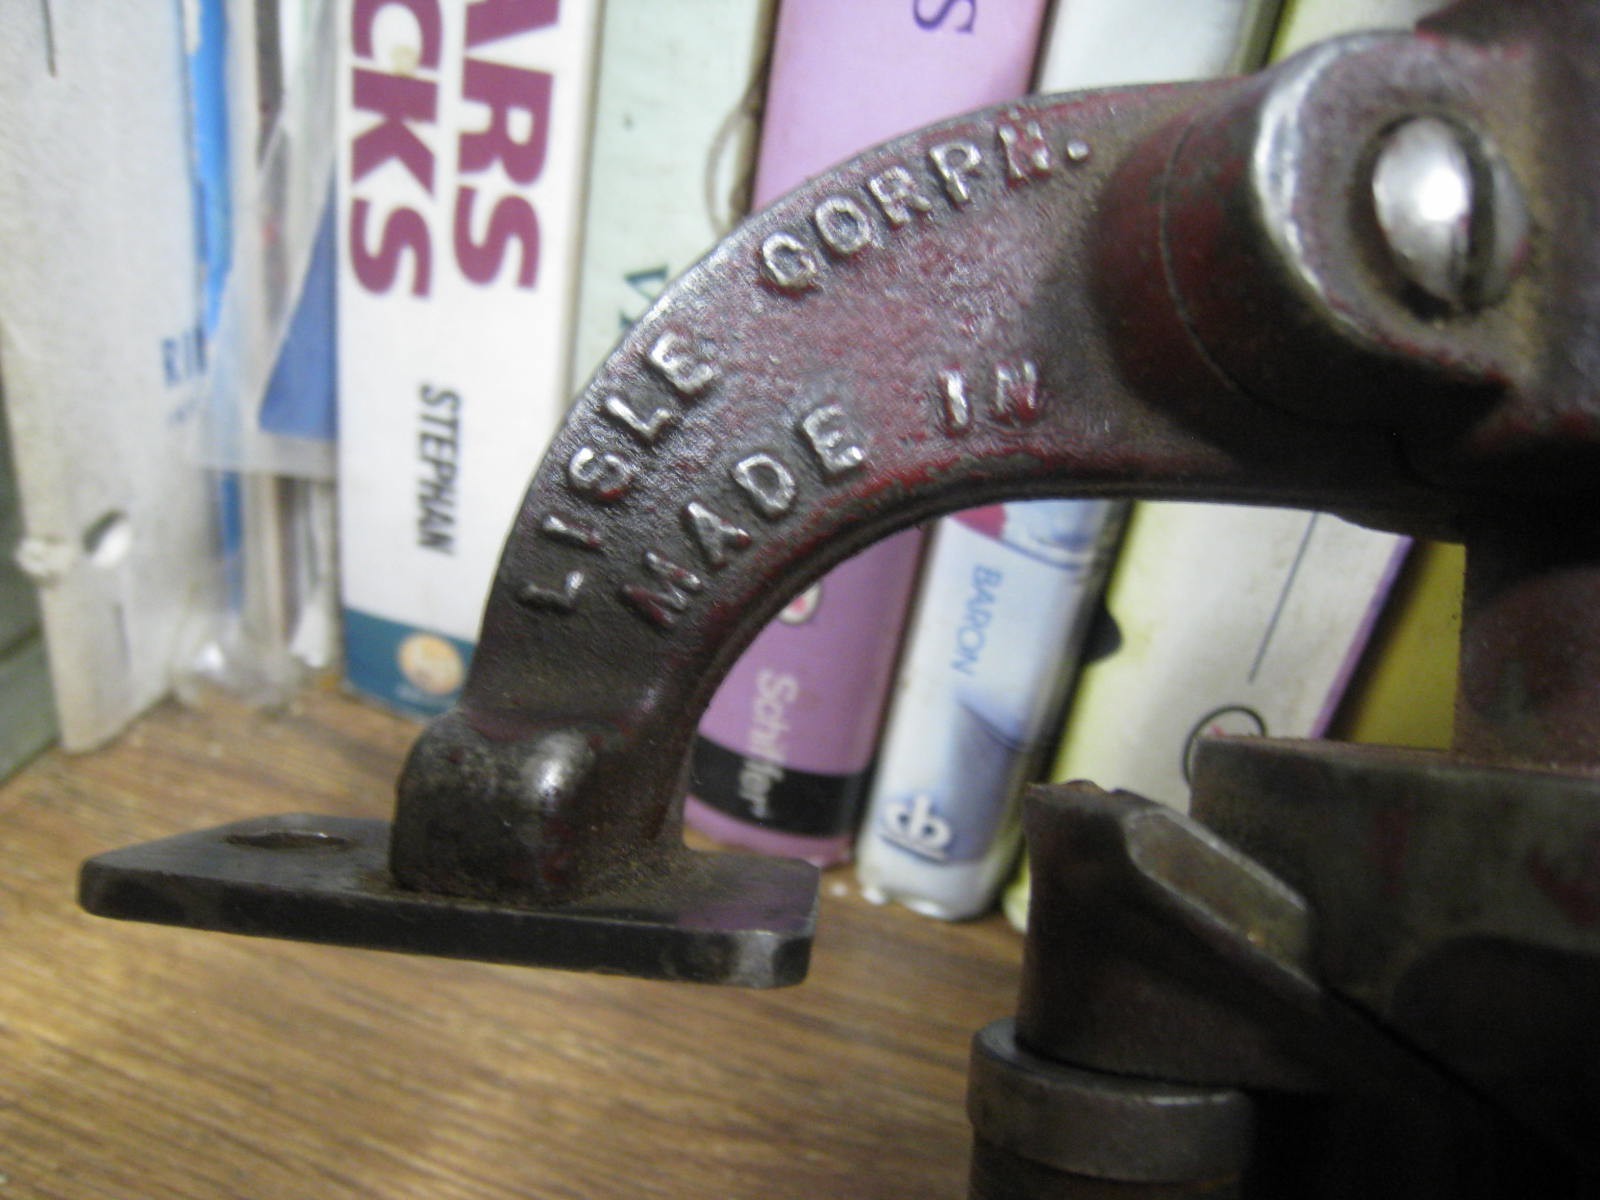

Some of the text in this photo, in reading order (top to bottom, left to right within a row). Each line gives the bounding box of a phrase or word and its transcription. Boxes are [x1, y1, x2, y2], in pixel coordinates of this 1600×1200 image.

[350, 0, 443, 299] CKS
[417, 383, 462, 556] STEPHAN
[517, 331, 717, 610] LISLE
[619, 358, 1040, 630] MADE IN
[951, 564, 1005, 676] BARON
